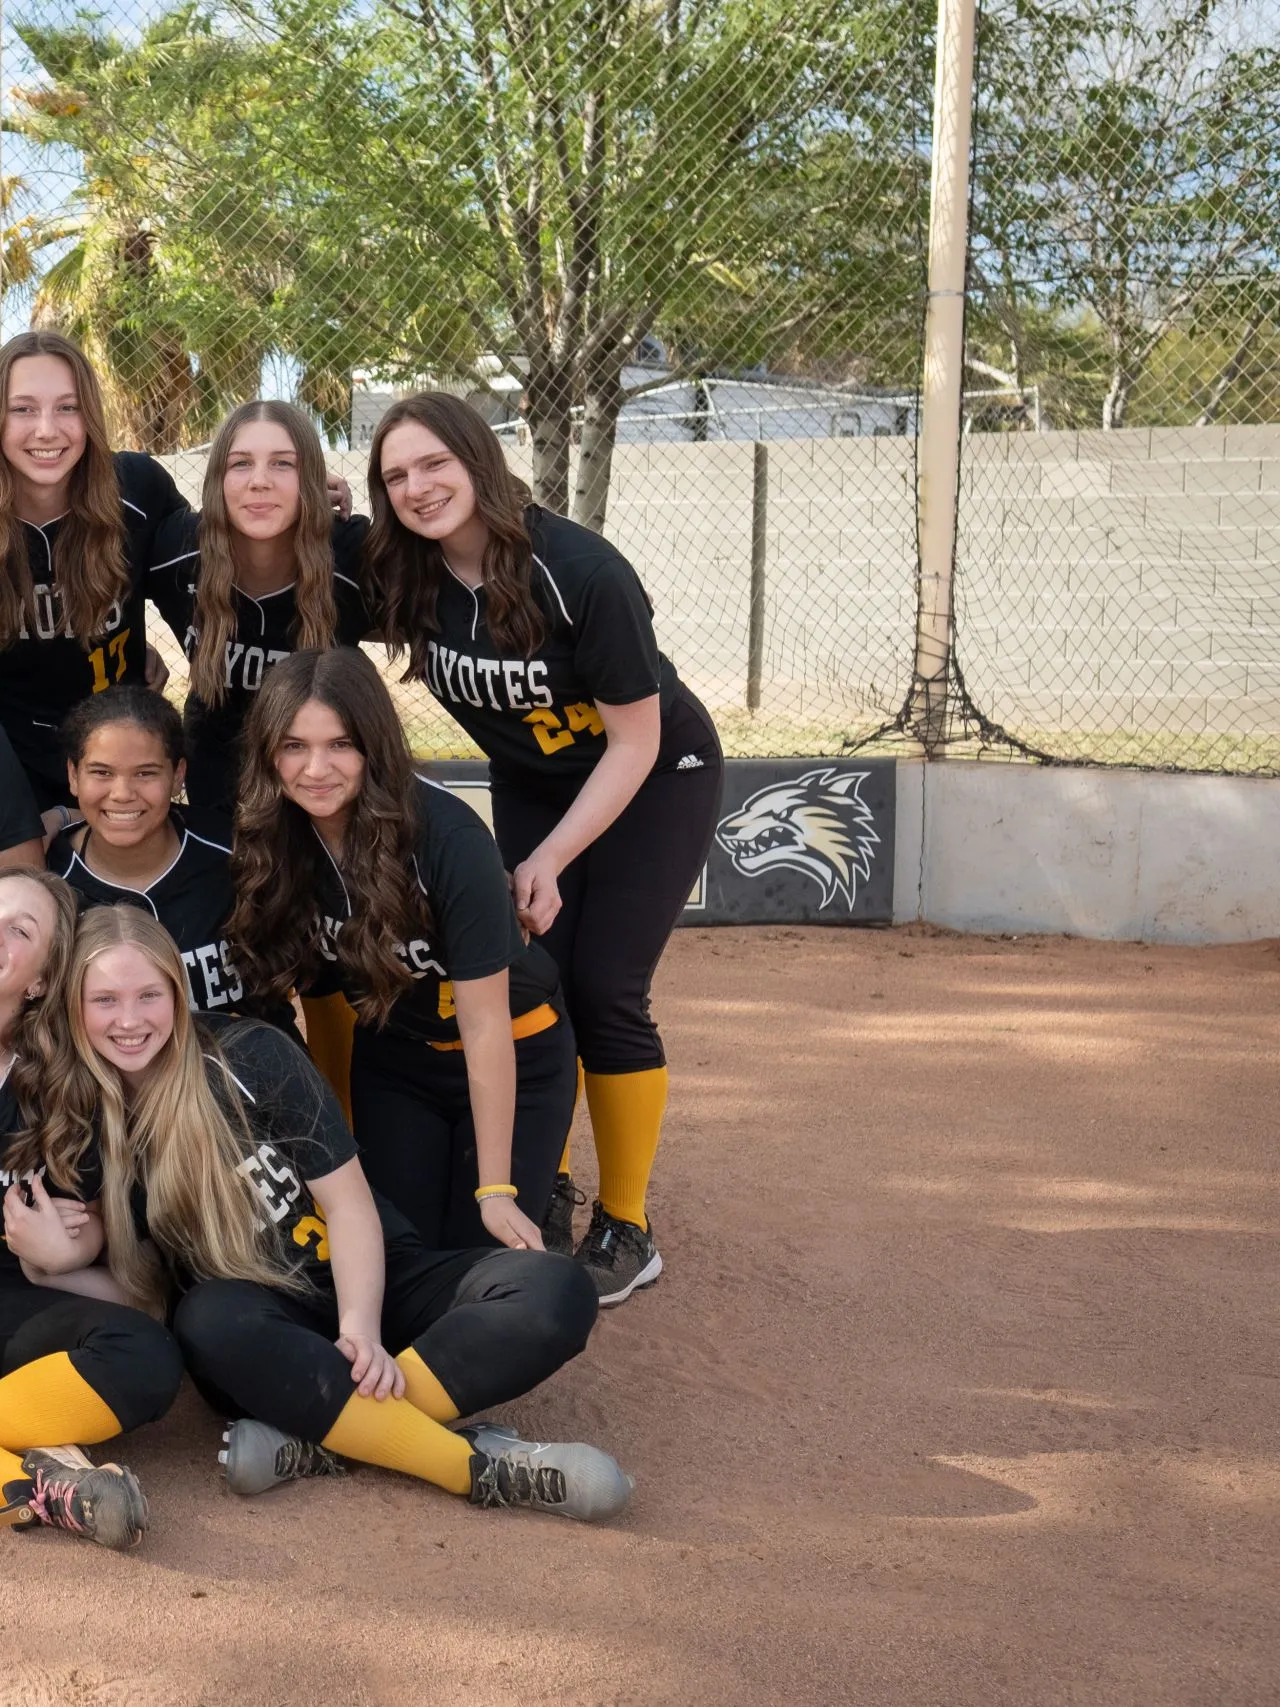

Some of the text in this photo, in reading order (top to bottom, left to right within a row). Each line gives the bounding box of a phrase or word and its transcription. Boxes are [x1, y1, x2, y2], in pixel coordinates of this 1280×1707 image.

[88, 628, 131, 694] 17
[521, 702, 606, 756] 24
[235, 1144, 301, 1232] ES
